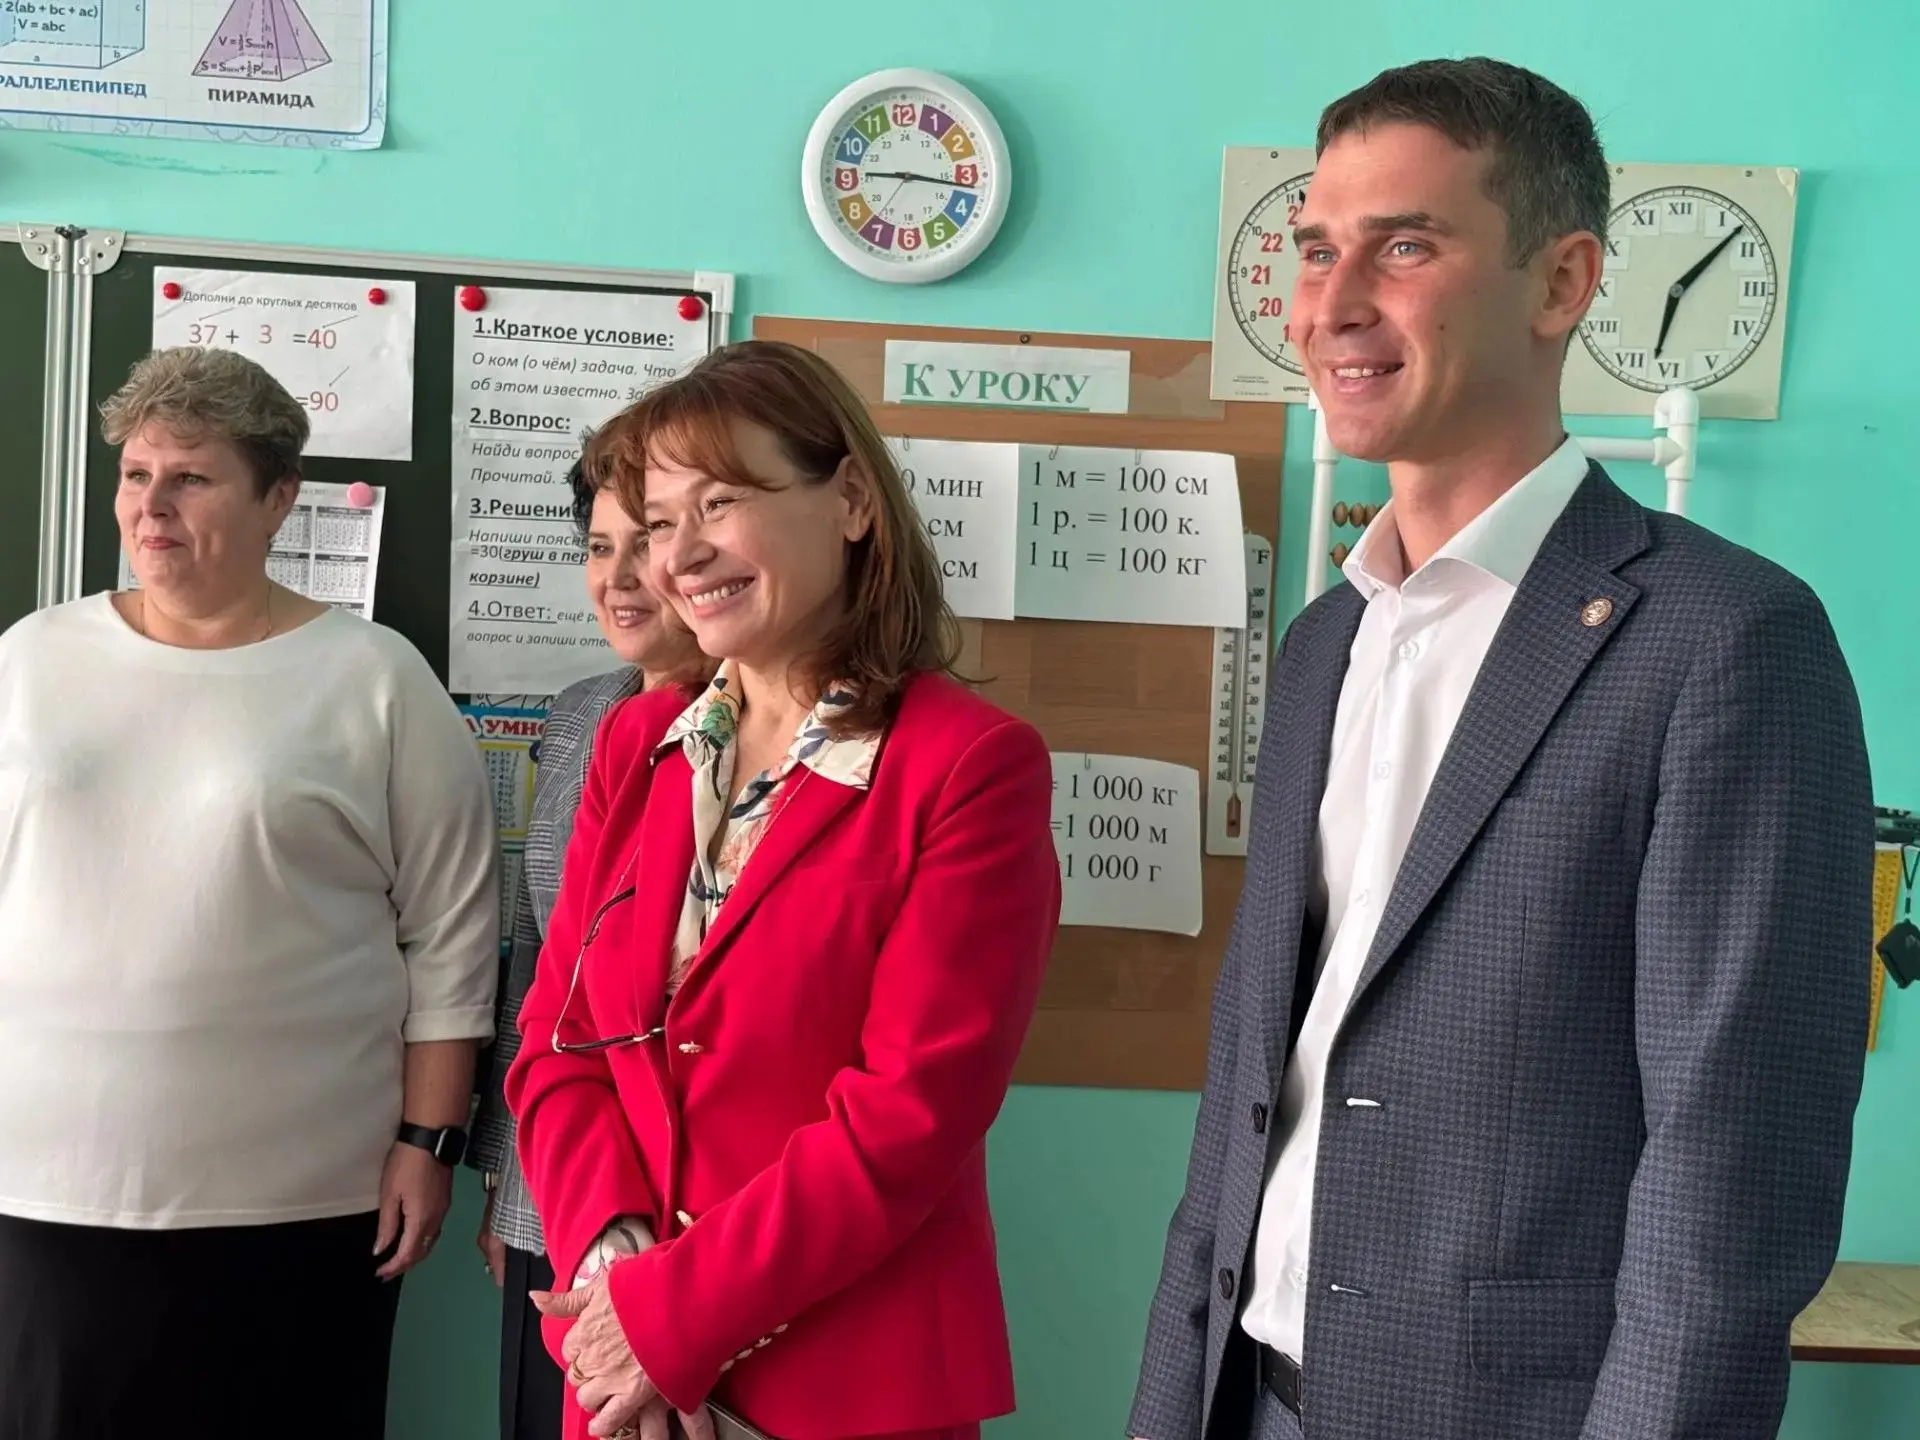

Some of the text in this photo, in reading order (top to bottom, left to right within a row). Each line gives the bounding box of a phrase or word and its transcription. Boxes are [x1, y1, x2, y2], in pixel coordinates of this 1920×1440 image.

[18, 19, 28, 29] V
[42, 21, 66, 32] abc
[208, 88, 315, 109] ПИРАМИДА
[864, 115, 880, 133] 11
[894, 108, 915, 124] 12
[930, 113, 938, 131] 1
[844, 138, 862, 156] 10
[882, 141, 892, 149] 23
[952, 135, 964, 152] 2
[933, 152, 942, 160] 14
[841, 171, 852, 187] 9
[960, 167, 972, 184] 3
[872, 194, 881, 202] 20
[935, 192, 944, 200] 16
[1286, 193, 1295, 204] 11
[849, 203, 860, 220] 8
[955, 199, 967, 216] 4
[1668, 202, 1692, 215] XII
[1632, 210, 1654, 225] XI
[872, 225, 883, 242] 7
[903, 231, 915, 248] 6
[933, 222, 945, 240] 5
[1251, 225, 1262, 237] 10
[1261, 233, 1283, 253] 22
[1740, 242, 1755, 257] II
[1240, 267, 1248, 278] 9
[1251, 265, 1271, 285] 21
[1744, 281, 1766, 297] III
[183, 290, 357, 311] Дополни до круглых десятков
[1259, 297, 1282, 317] 20
[1250, 310, 1257, 321] 8
[188, 324, 218, 345] 37
[259, 325, 273, 344] 3
[474, 317, 675, 348] 1.Краткое условие:
[1588, 320, 1618, 334] VIII
[1733, 320, 1756, 336] IV
[1278, 343, 1285, 354] 7
[472, 352, 677, 378] О ком (о чём) задача. Что
[1616, 352, 1645, 368] VII
[1704, 355, 1720, 370] V
[1658, 362, 1680, 378] VI
[471, 376, 491, 391] об
[494, 382, 538, 395] этом
[543, 384, 621, 400] известно.
[902, 363, 1092, 404] К УРОКУ
[469, 407, 571, 430] 2.Вопрос:
[471, 442, 579, 461] Найди вопрос
[471, 467, 556, 484] Прочитай.
[1032, 461, 1041, 486] 1
[1056, 468, 1077, 489] м
[1117, 466, 1167, 494] 100
[1175, 476, 1209, 495] см
[926, 477, 985, 499] мин
[1031, 501, 1040, 527] 1
[1053, 509, 1077, 535] р.
[1119, 506, 1168, 535] 100
[1177, 516, 1200, 536] к.
[928, 518, 964, 537] см
[469, 530, 532, 545] Напиши
[549, 552, 558, 561] в
[1029, 542, 1038, 567] 1
[1051, 550, 1069, 573] ц
[1118, 547, 1167, 575] 100
[1176, 556, 1207, 576] кг
[942, 560, 978, 579] см
[469, 572, 540, 587] корзине)
[468, 600, 551, 619] 4.Ответ:
[557, 609, 584, 623] ещё
[467, 633, 512, 645] вопрос
[515, 635, 524, 644] и
[526, 635, 576, 647] запиши
[1071, 774, 1079, 798] 1
[1093, 775, 1143, 802] 000
[1152, 787, 1178, 806] кг
[1089, 814, 1140, 841] 000
[1149, 826, 1169, 845] м
[1066, 854, 1162, 882] 1 000 г
